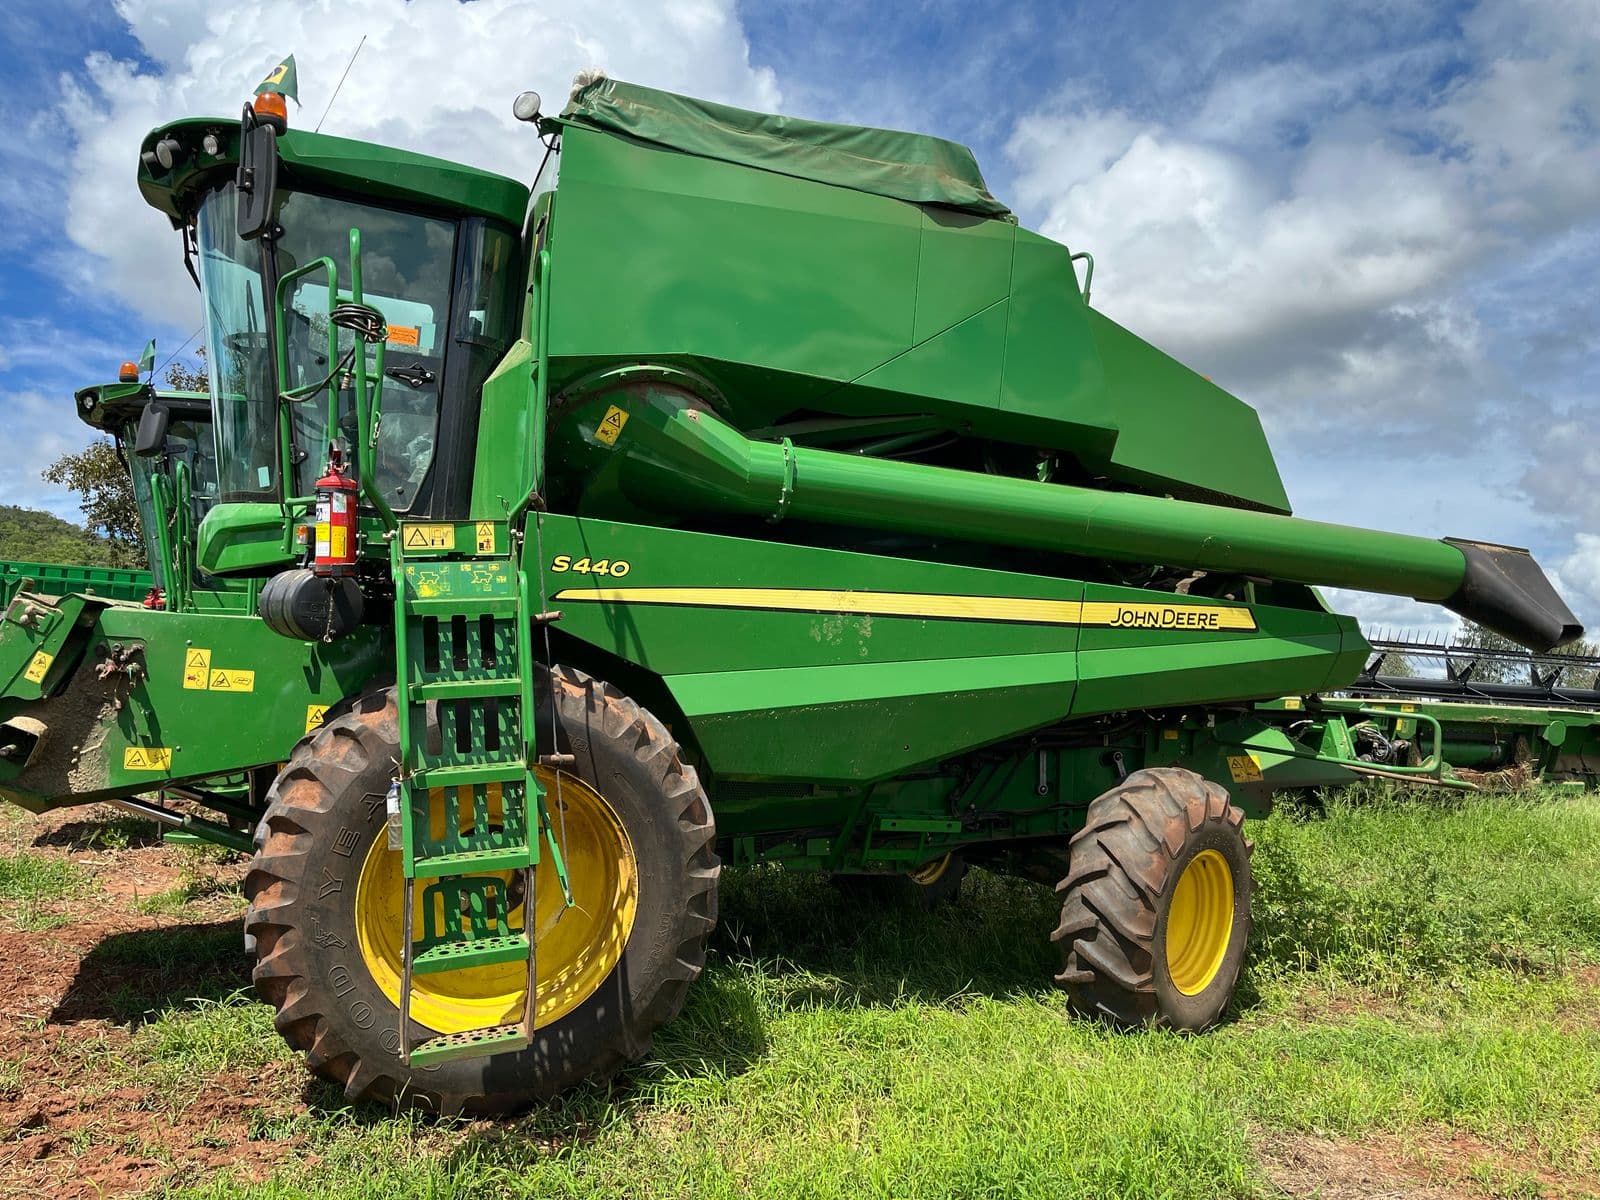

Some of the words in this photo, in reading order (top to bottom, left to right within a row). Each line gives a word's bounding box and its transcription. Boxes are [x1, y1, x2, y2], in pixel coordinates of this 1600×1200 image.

[551, 554, 630, 577] S440
[1111, 607, 1159, 625] JOHN
[1162, 608, 1219, 626] DEERE
